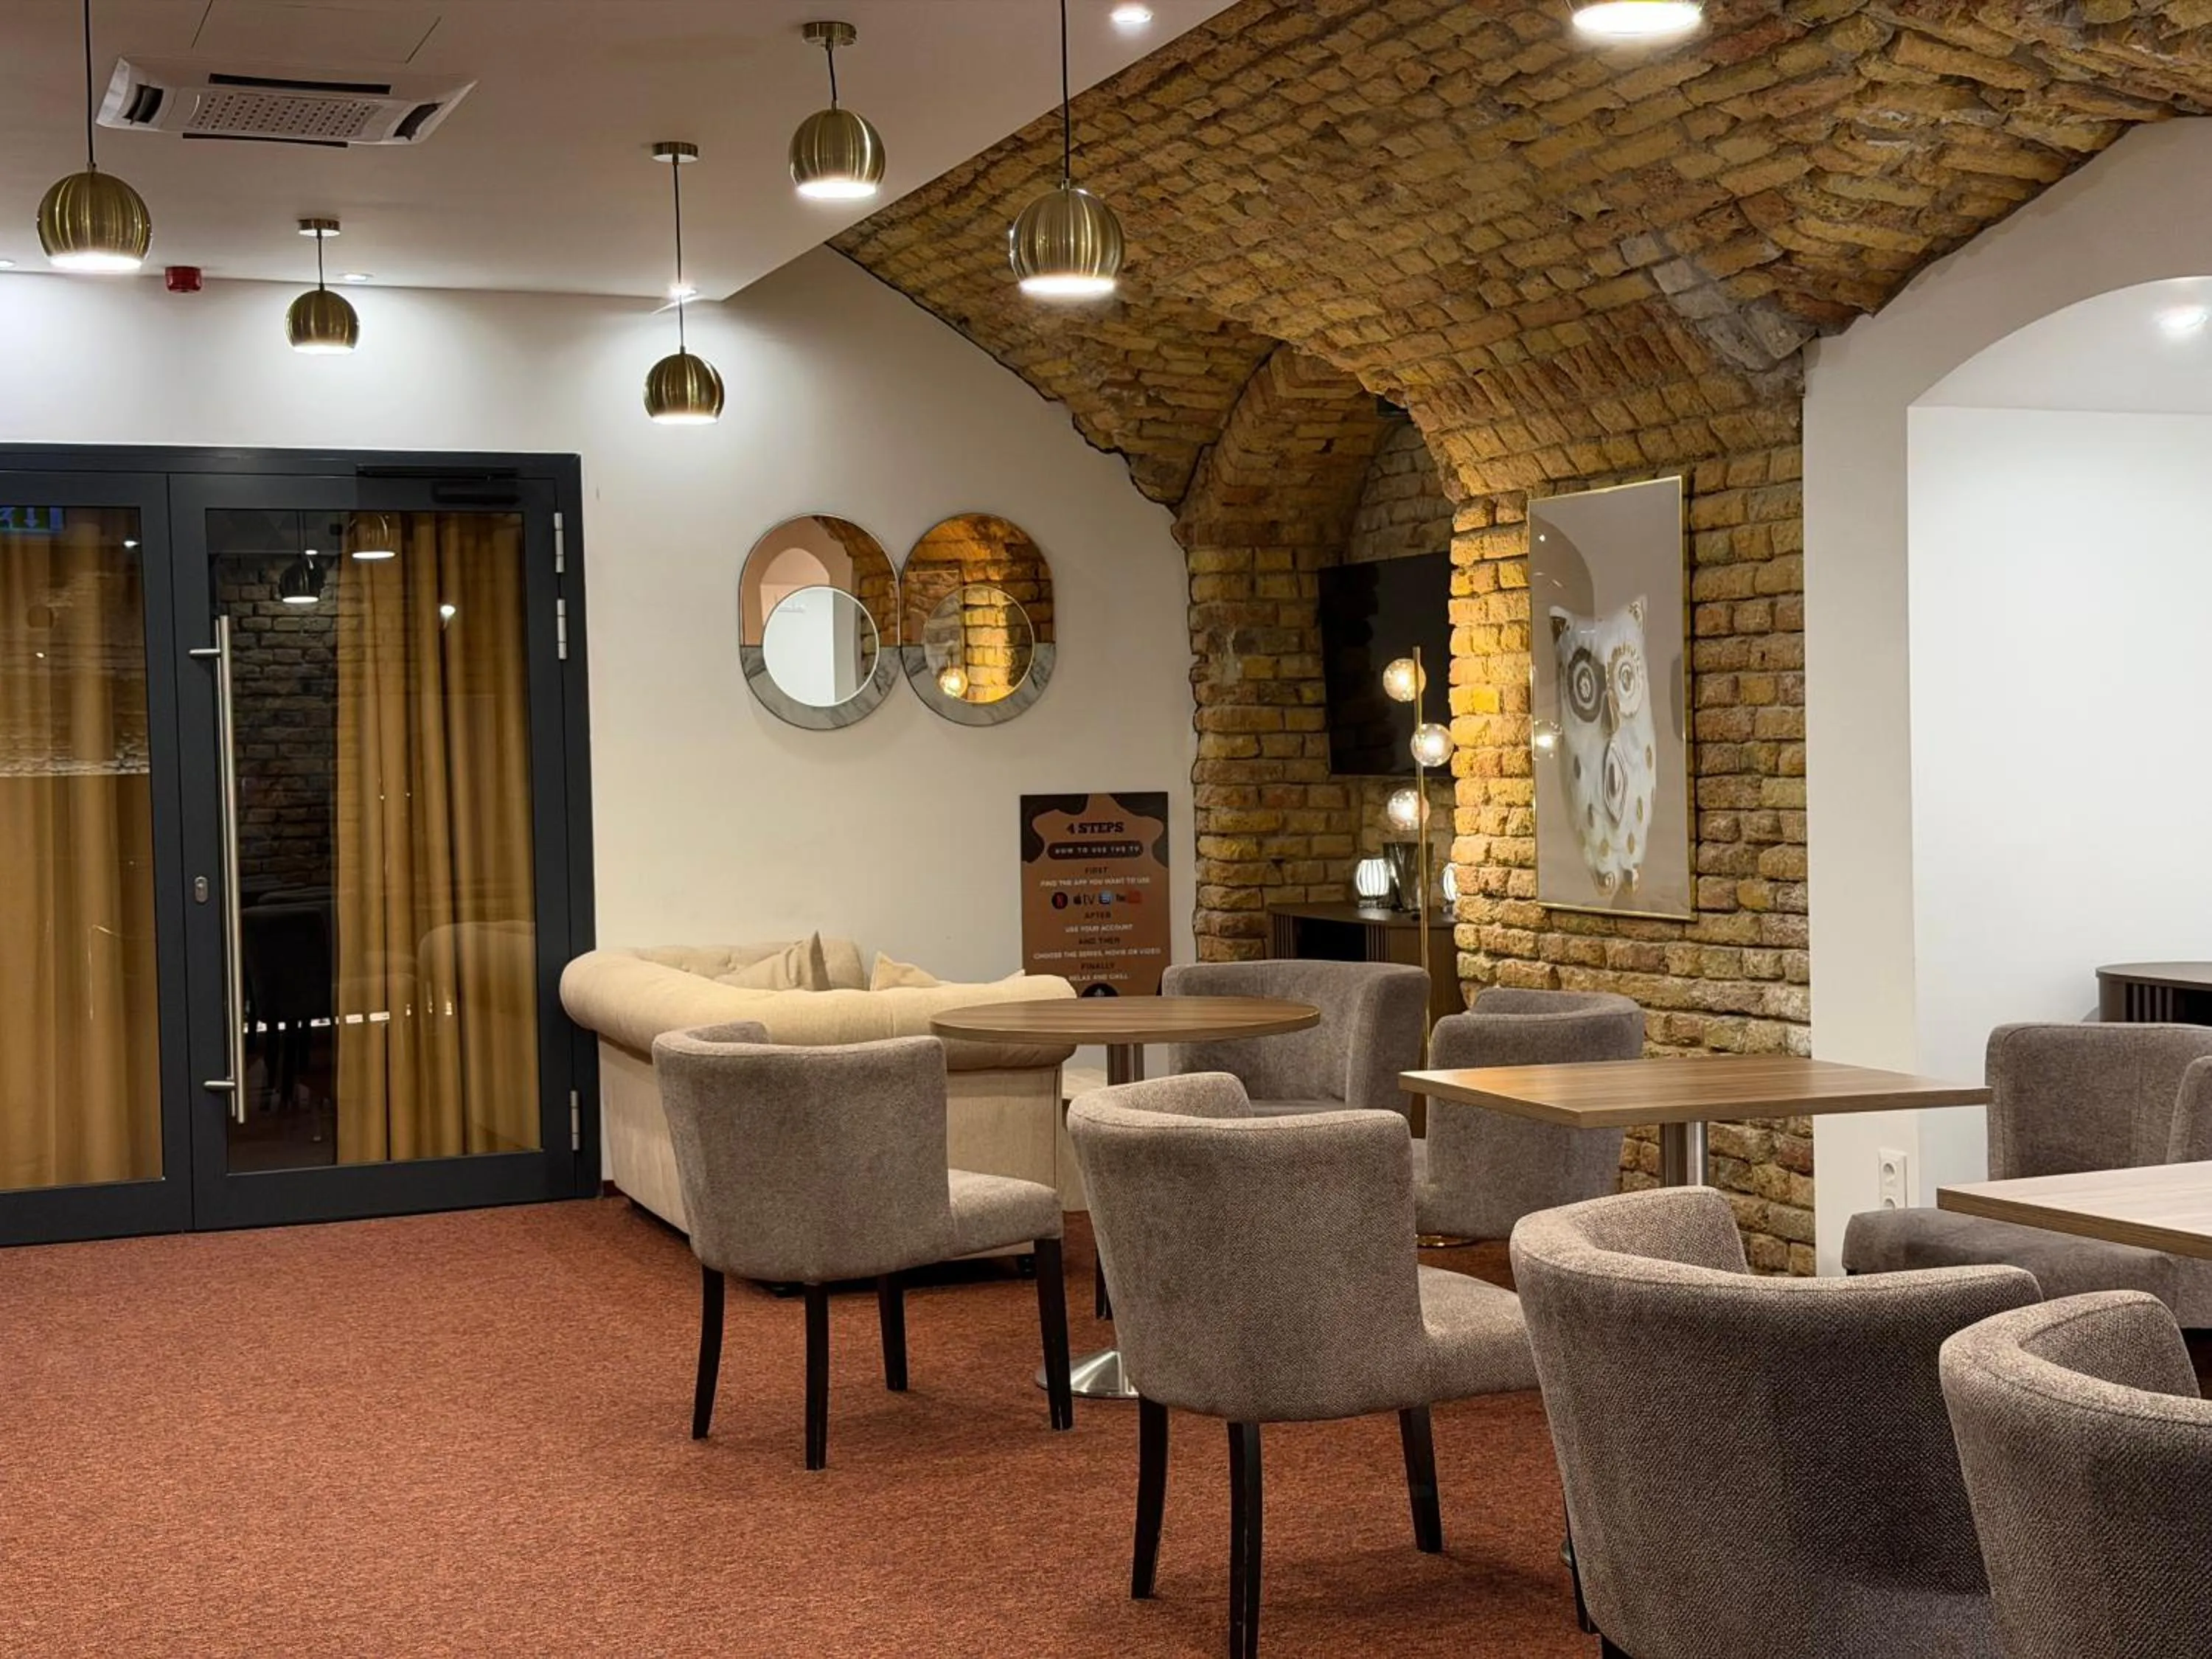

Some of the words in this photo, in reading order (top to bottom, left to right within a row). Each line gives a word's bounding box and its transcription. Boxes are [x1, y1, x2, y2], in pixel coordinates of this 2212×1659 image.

[1066, 822, 1074, 834] 4
[1077, 821, 1124, 834] STEPS
[1085, 911, 1111, 919] AFTER
[1034, 951, 1062, 959] CHOOSE
[1081, 961, 1116, 970] FINALLY
